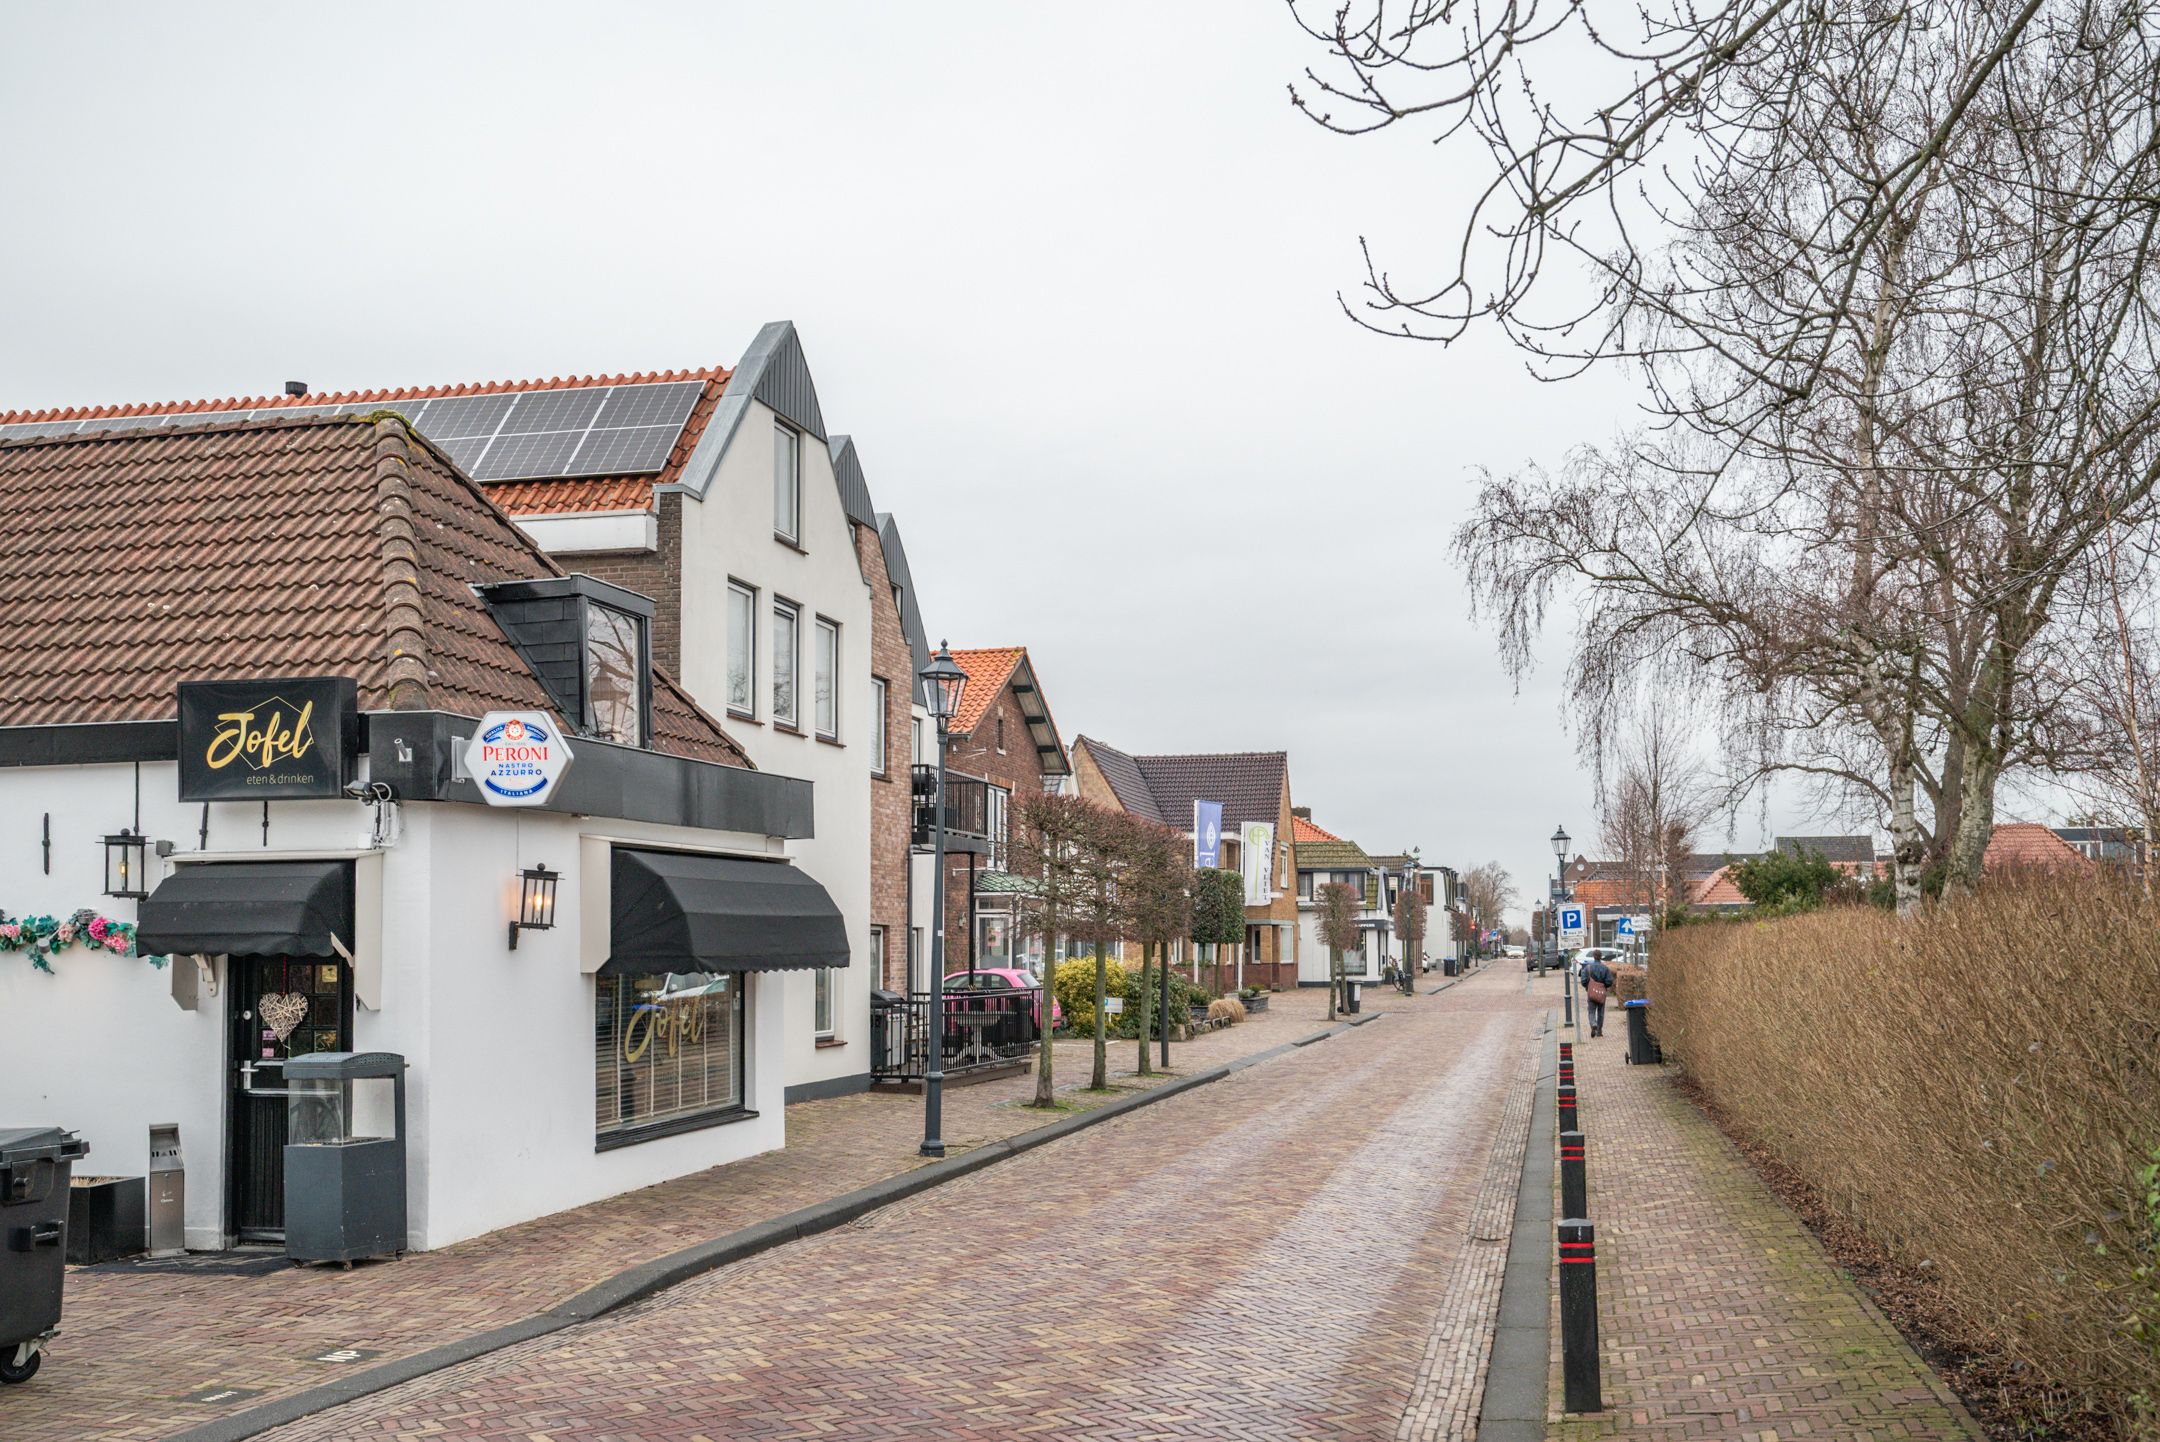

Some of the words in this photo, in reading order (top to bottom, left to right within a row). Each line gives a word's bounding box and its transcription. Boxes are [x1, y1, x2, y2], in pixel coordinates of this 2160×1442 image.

[207, 700, 313, 769] Jofel
[483, 745, 548, 761] PERONI
[624, 993, 706, 1063] Jofel
